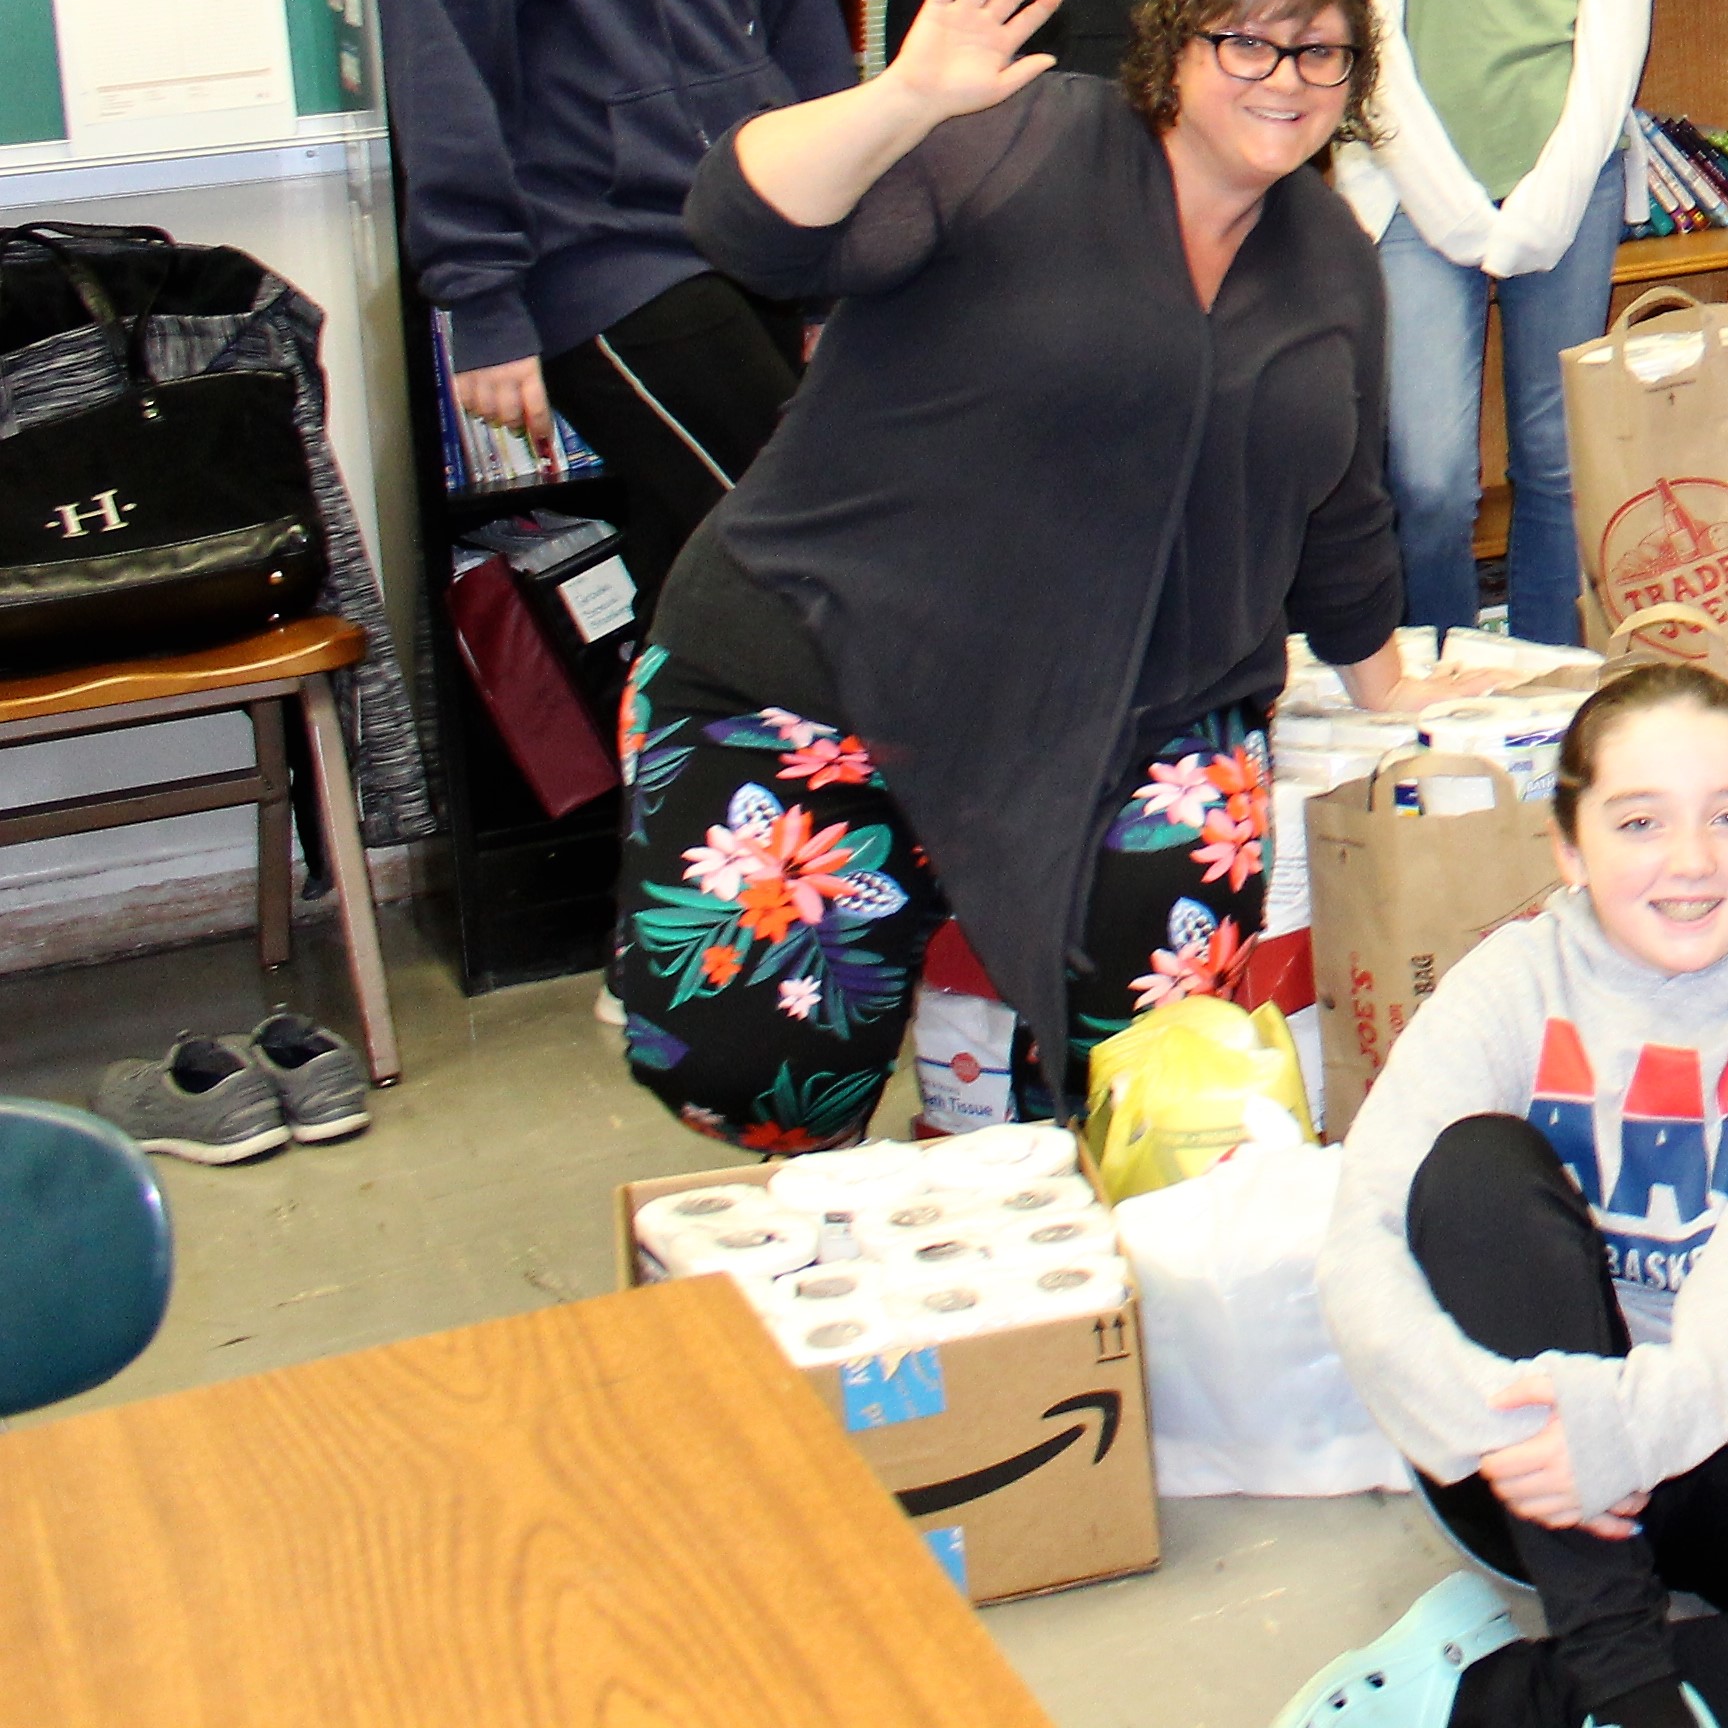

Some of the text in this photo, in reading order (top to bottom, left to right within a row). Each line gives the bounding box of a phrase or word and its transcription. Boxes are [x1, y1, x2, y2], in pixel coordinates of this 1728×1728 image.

[1410, 953, 1436, 997] BAG
[1349, 968, 1381, 1069] JOE'S
[949, 1097, 993, 1117] Tissue
